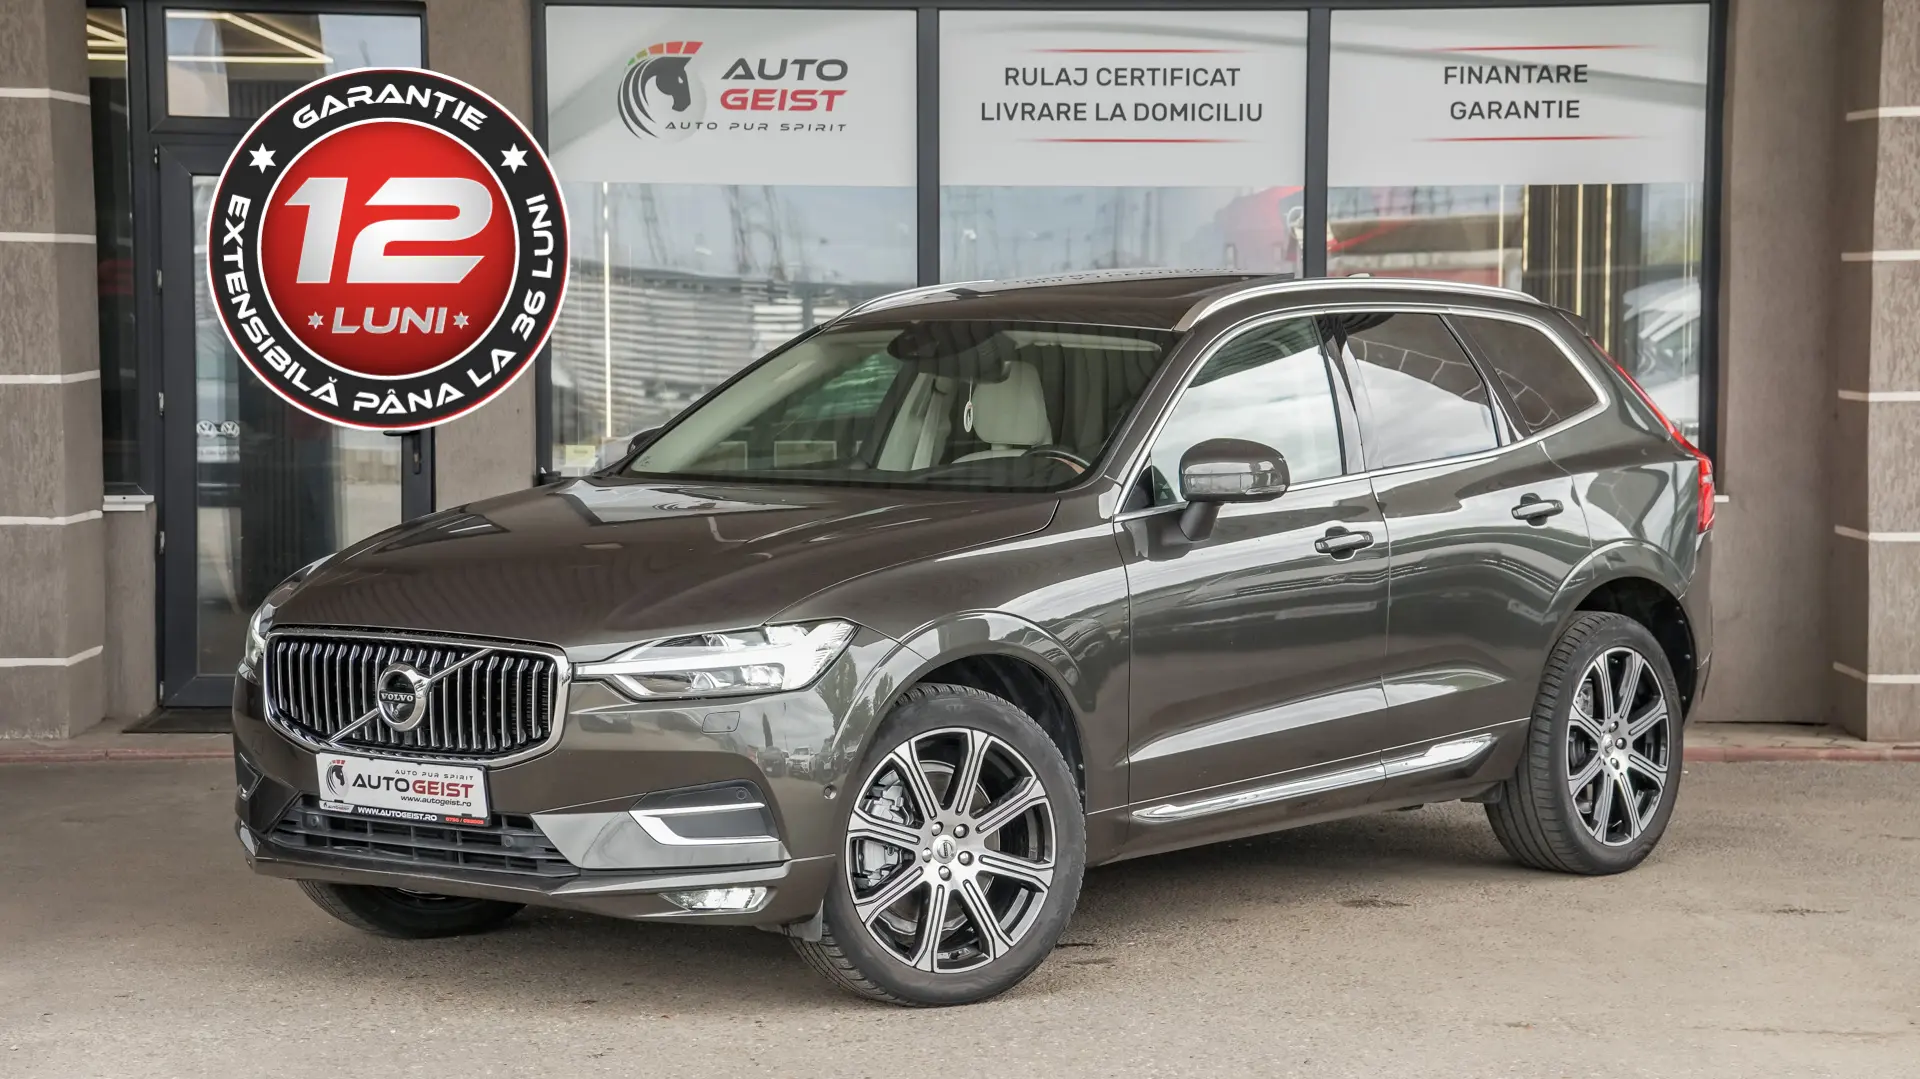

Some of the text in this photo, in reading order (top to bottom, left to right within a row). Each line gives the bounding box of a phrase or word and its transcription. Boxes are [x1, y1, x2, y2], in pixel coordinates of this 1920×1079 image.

[721, 57, 848, 81] AUTO
[1005, 67, 1240, 87] RULAJ CERTIFICAT
[1444, 64, 1588, 84] FINANTARE
[720, 88, 848, 112] GEIST
[1450, 100, 1580, 120] GARANTIE
[981, 102, 1262, 122] LIVRARE LA DOMICILIU
[665, 121, 847, 132] AUTO PUR SPIRIT
[381, 693, 414, 702] VOLVO
[443, 773, 474, 781] SPIRIT
[400, 795, 472, 807] www.autogeist.ro
[357, 806, 438, 822] WWW.AUTOGEIST.RO
